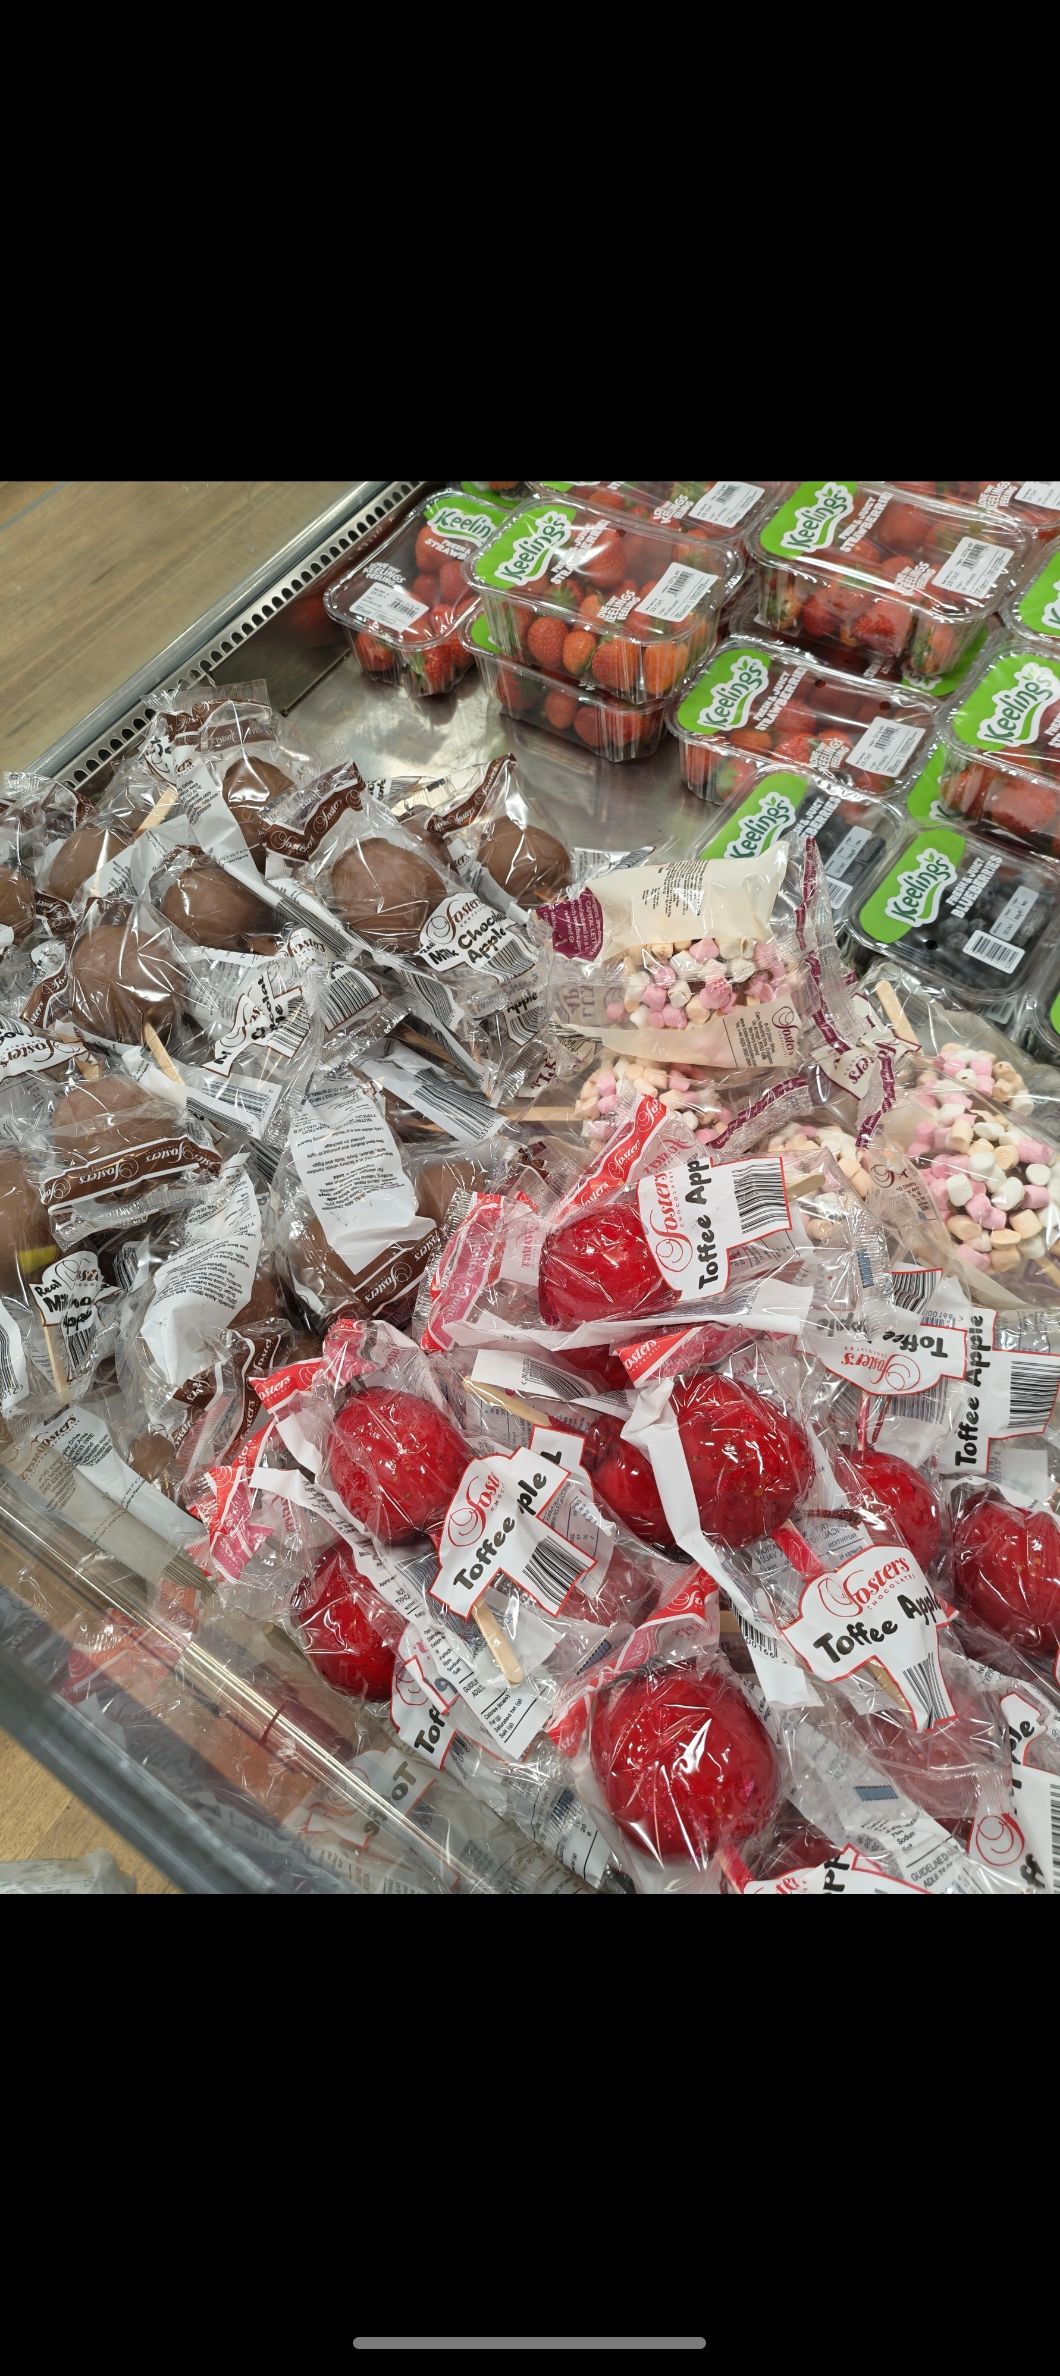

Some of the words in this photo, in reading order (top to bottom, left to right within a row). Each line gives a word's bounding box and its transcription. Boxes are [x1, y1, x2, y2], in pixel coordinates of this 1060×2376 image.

[502, 516, 566, 581] Keelings
[788, 493, 848, 551] Keelings
[705, 664, 763, 729] Keelings
[770, 669, 791, 696] JUICY
[731, 802, 789, 856] Keelings
[804, 796, 824, 819] JUICY
[891, 861, 952, 923] Keelings
[946, 880, 968, 907] FRESH
[965, 855, 985, 879] JUICY
[951, 852, 1003, 920] BLUEBERRIES
[429, 945, 461, 966] Milk
[771, 1006, 799, 1056] Fosters
[78, 1156, 139, 1187] Fosters
[650, 1169, 695, 1272] Fosters
[696, 1214, 720, 1290] Toffee
[35, 1279, 61, 1298] Real
[882, 1329, 949, 1359] Toffee
[965, 1314, 991, 1387] Apple
[954, 1396, 980, 1467] Toffee
[452, 1516, 516, 1591] Toffee
[817, 1556, 911, 1618] Fosters
[812, 1617, 899, 1664] Toffee
